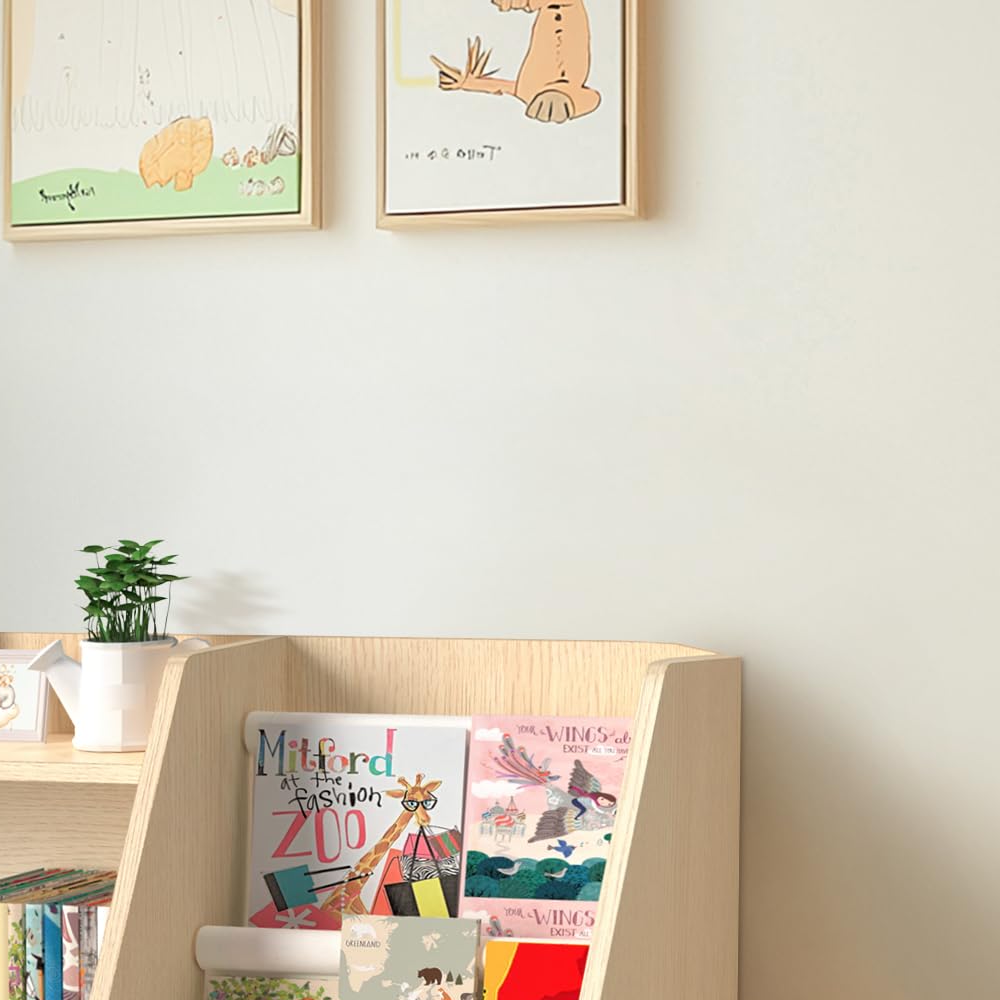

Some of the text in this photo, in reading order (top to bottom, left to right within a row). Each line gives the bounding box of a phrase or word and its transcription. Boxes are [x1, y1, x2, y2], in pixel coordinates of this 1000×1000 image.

[545, 725, 608, 743] WINGS
[256, 728, 397, 777] Mitford
[563, 744, 589, 753] EXIST
[280, 771, 342, 790] at the
[288, 782, 382, 819] fashion
[271, 807, 366, 863] ZOO
[533, 908, 595, 927] WINGS
[550, 928, 576, 937] EXIST
[345, 940, 381, 948] GREENLAND
